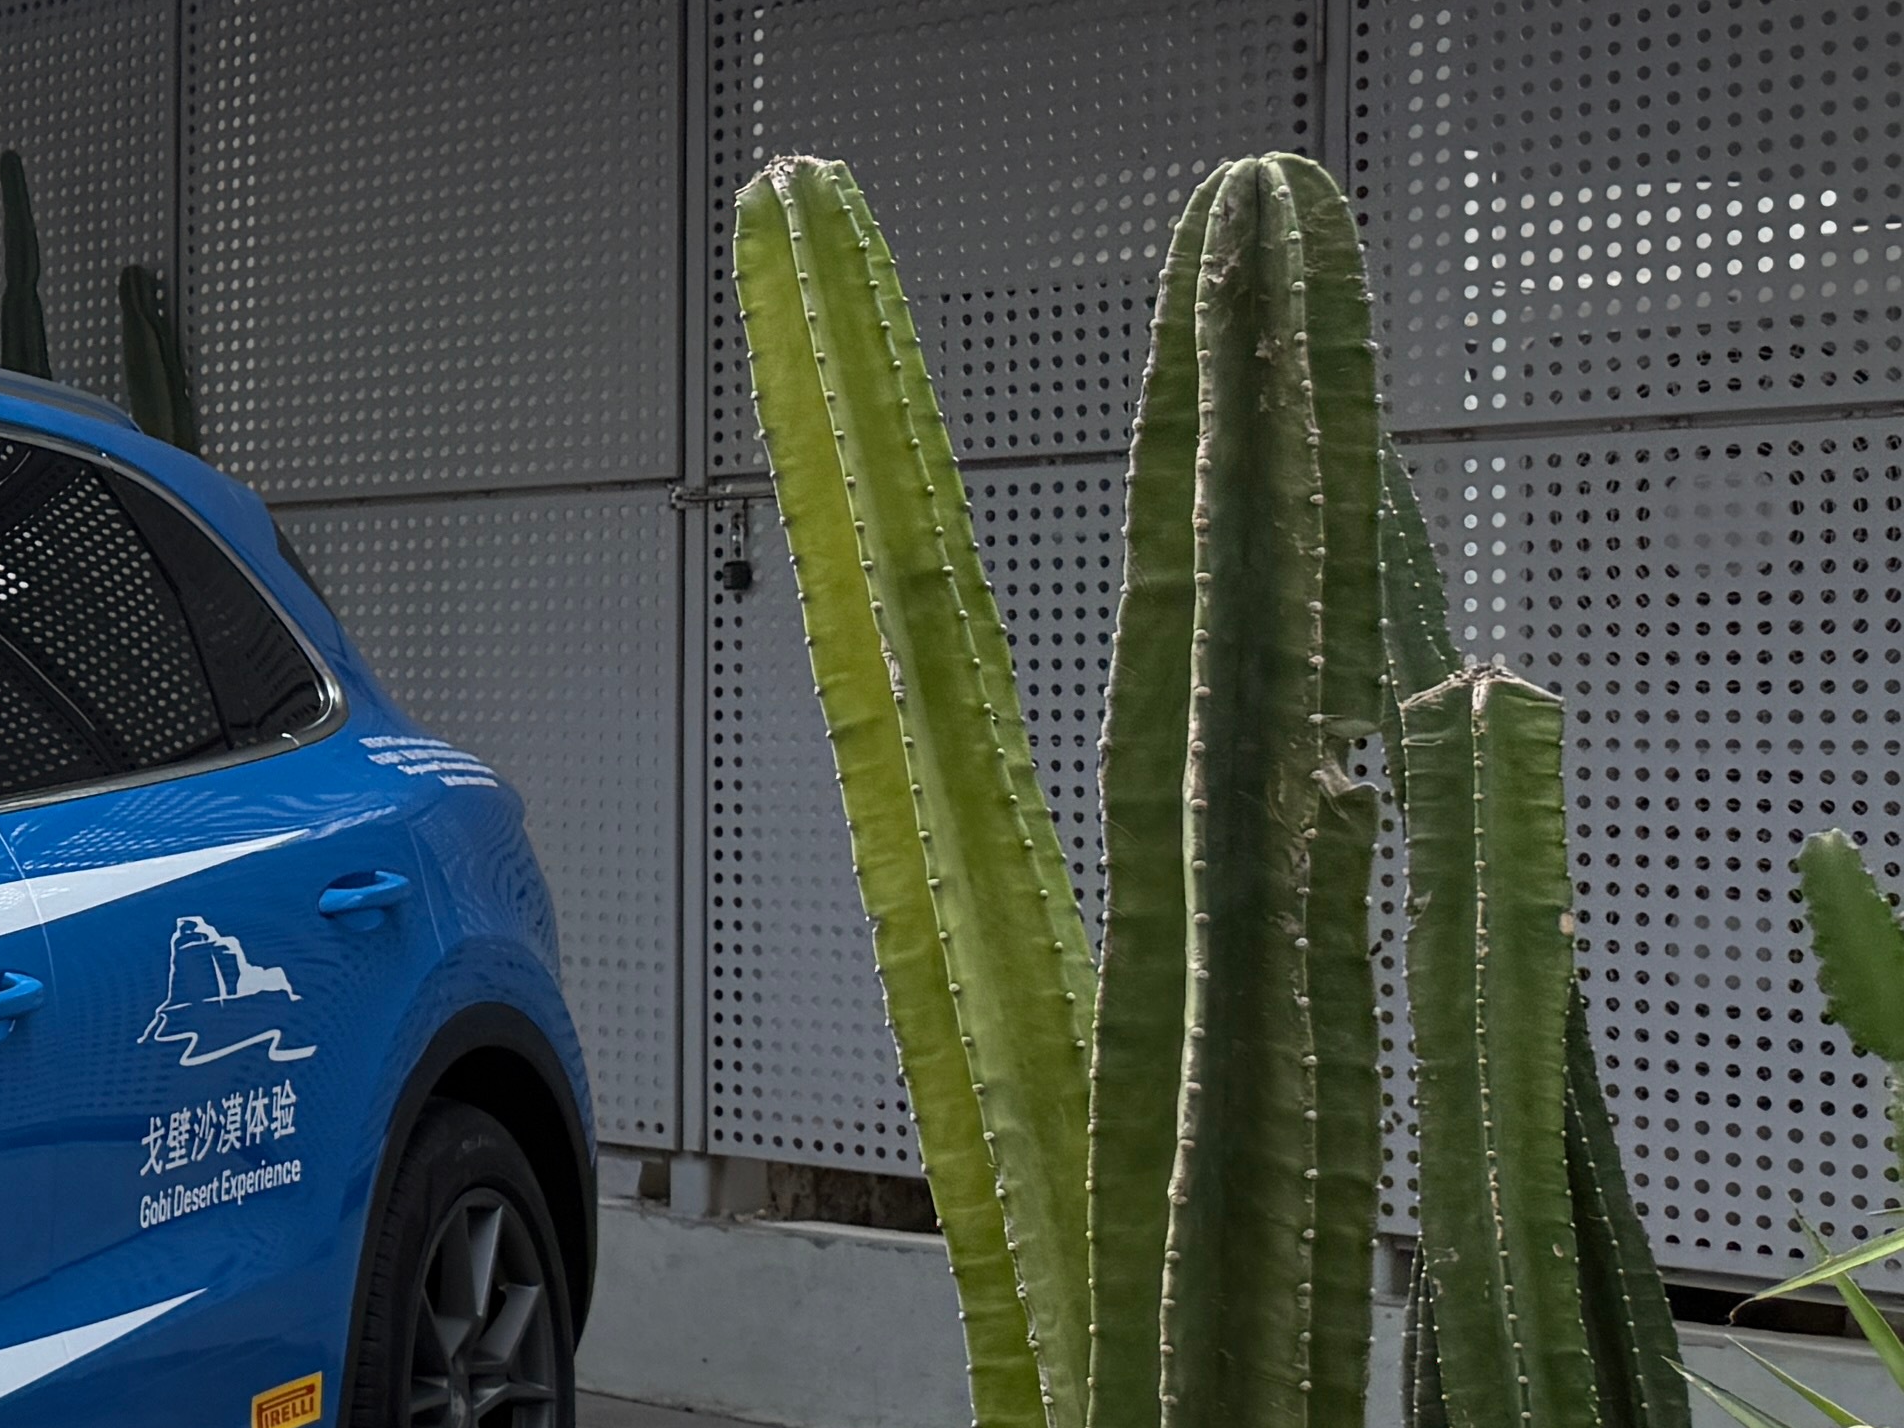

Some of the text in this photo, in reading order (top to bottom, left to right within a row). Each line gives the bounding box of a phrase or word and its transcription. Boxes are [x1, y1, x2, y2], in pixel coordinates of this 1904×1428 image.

[140, 1079, 297, 1177] 戈壁沙漠体验
[140, 1159, 301, 1229] Gobi Desert Experience
